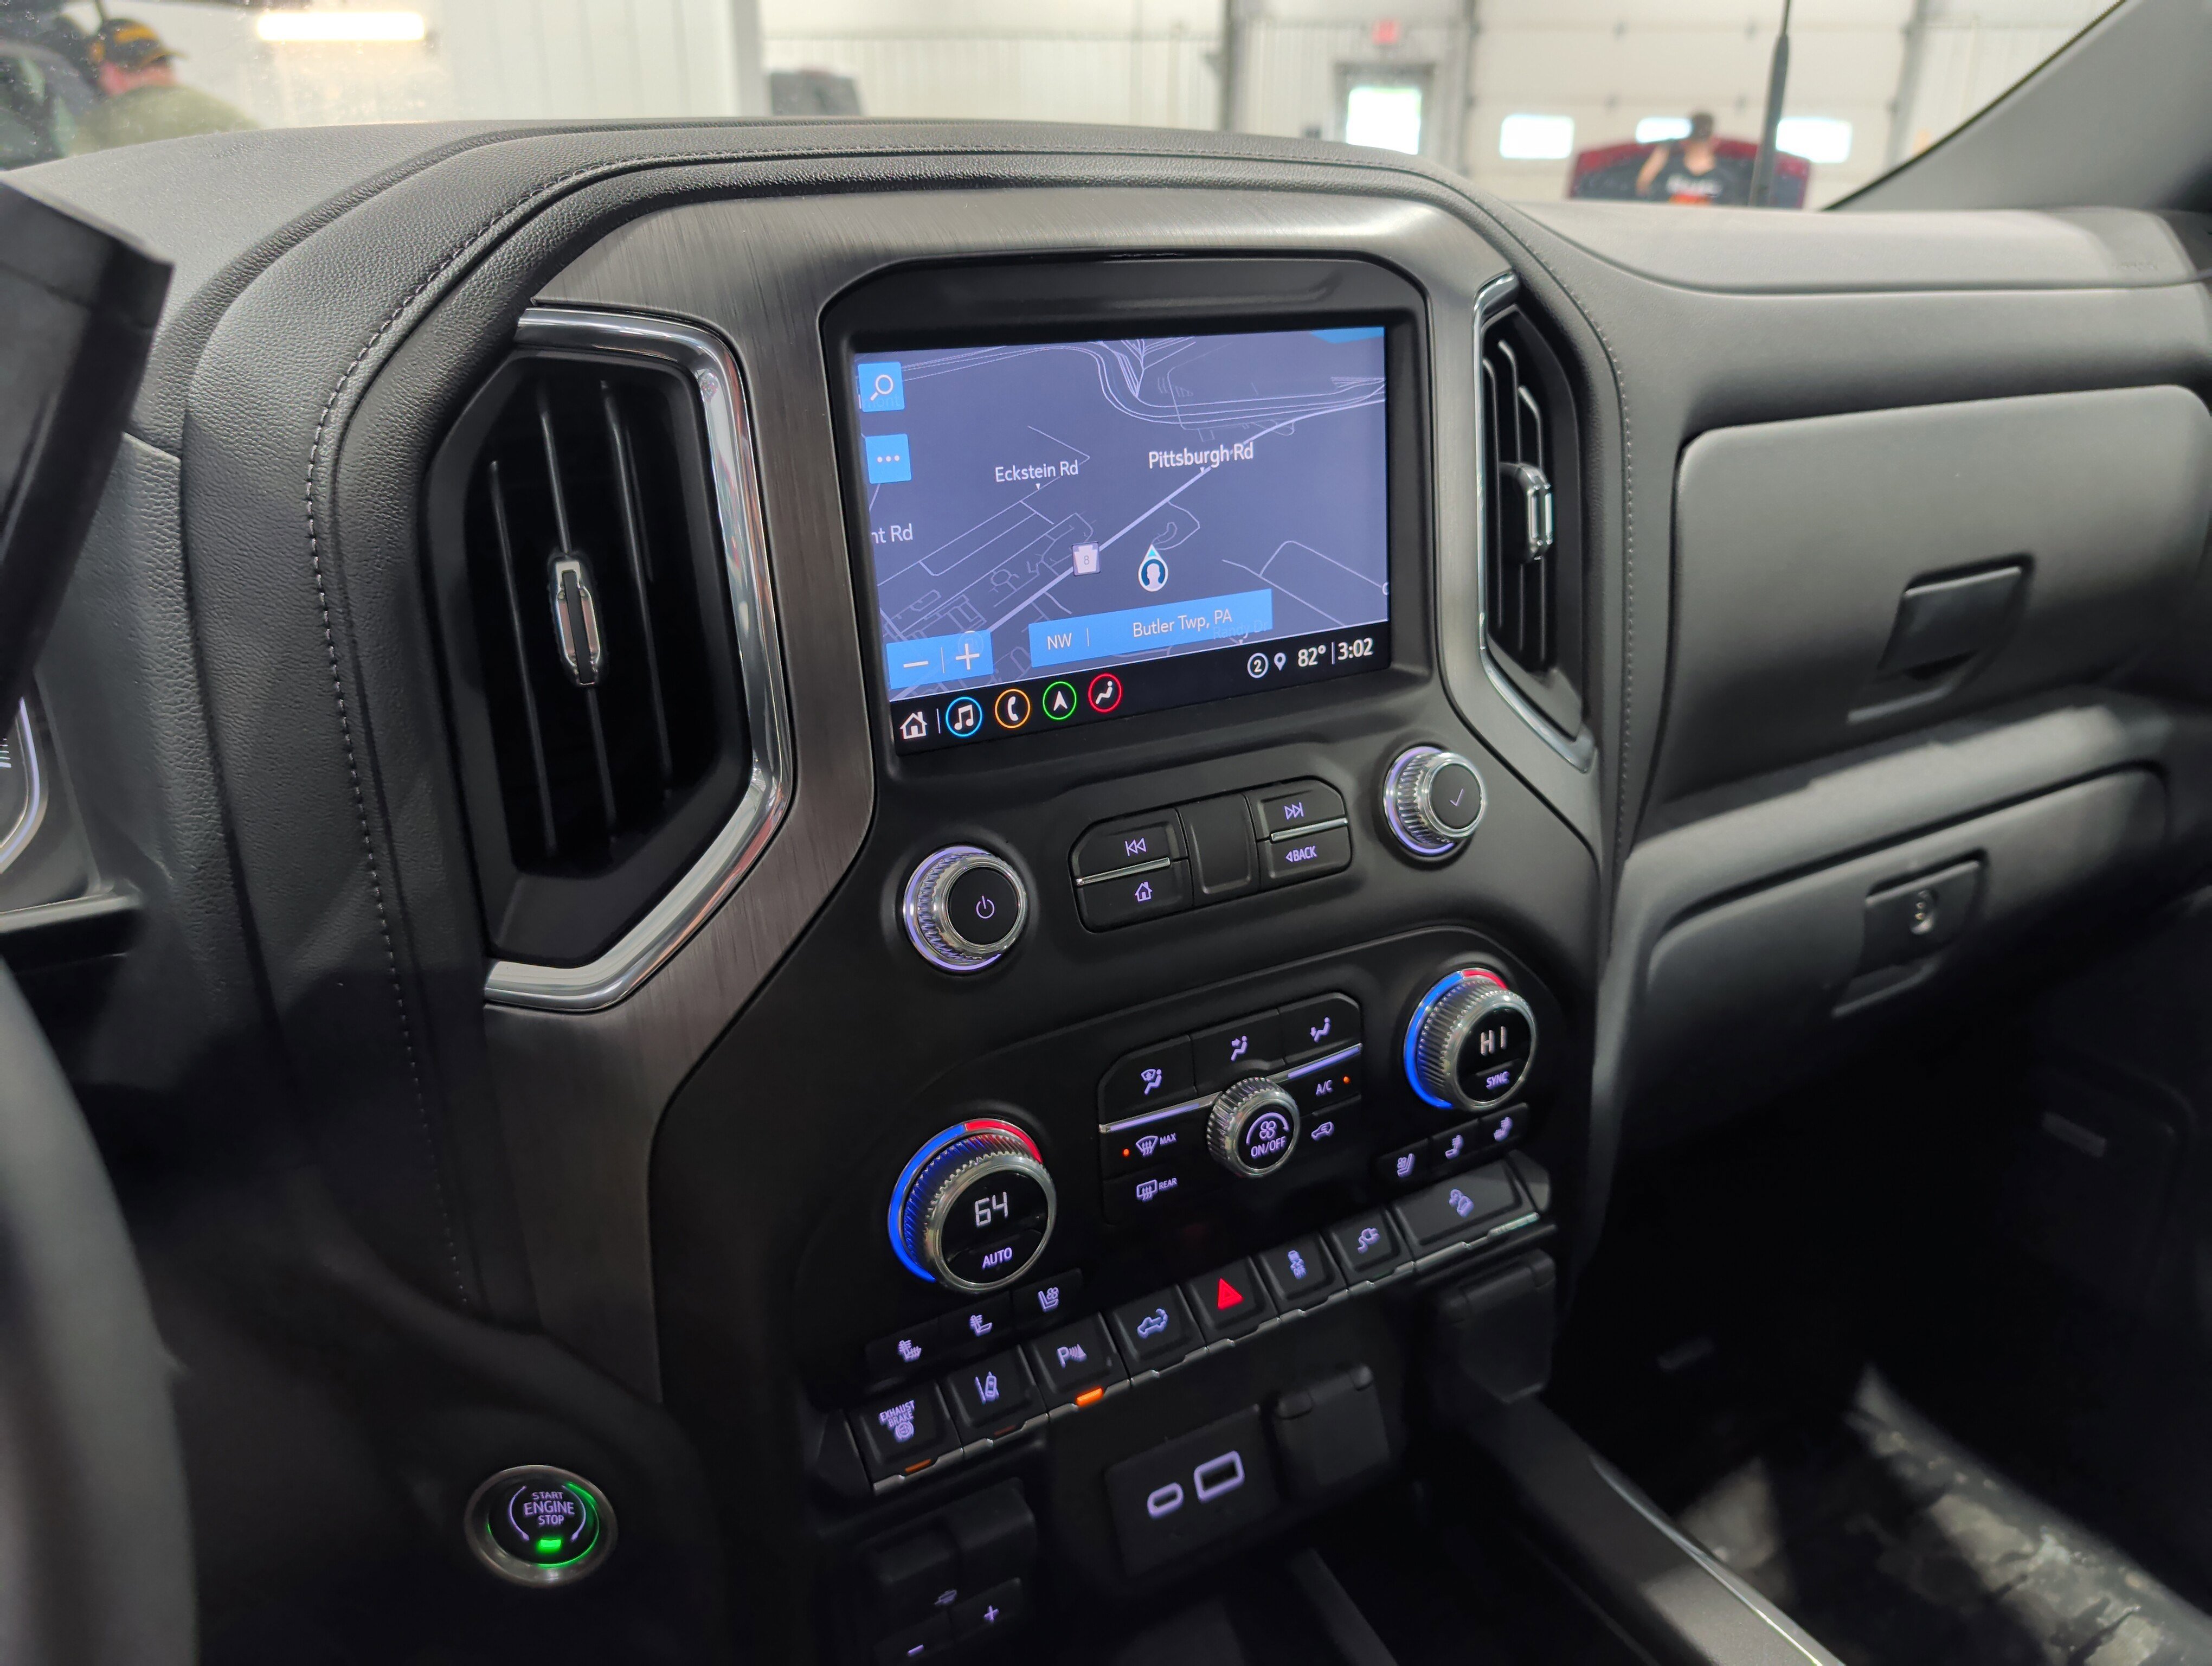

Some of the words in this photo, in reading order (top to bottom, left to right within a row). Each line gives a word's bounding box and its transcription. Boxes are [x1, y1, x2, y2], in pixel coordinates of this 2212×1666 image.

[1148, 444, 1230, 469] Pittsburgh
[1233, 441, 1253, 460] Rd
[995, 463, 1056, 482] Eckstein
[1060, 459, 1079, 476] Rd
[890, 523, 913, 542] Rd
[1084, 555, 1090, 565] 8
[1133, 618, 1175, 638] Butler
[1178, 614, 1211, 629] Twp,
[1214, 608, 1232, 625] PA
[1047, 633, 1072, 650] NW
[1338, 637, 1373, 661] 3:02
[1297, 644, 1327, 667] 82°
[1253, 659, 1262, 672] 2
[1293, 845, 1317, 862] BACK
[1481, 1026, 1507, 1056] HI
[1316, 1080, 1333, 1097] A/C
[1486, 1071, 1510, 1090] SYNC
[1159, 1132, 1176, 1146] MAX
[1251, 1137, 1287, 1159] ON/OFF
[1159, 1177, 1178, 1191] REAR
[974, 1191, 1008, 1228] 64
[982, 1247, 1013, 1270] AUTO
[879, 1400, 915, 1424] EXHAUST
[888, 1411, 914, 1429] BRAKE
[531, 1491, 563, 1501] START
[523, 1501, 575, 1517] ENGINE
[537, 1514, 565, 1526] STOP
